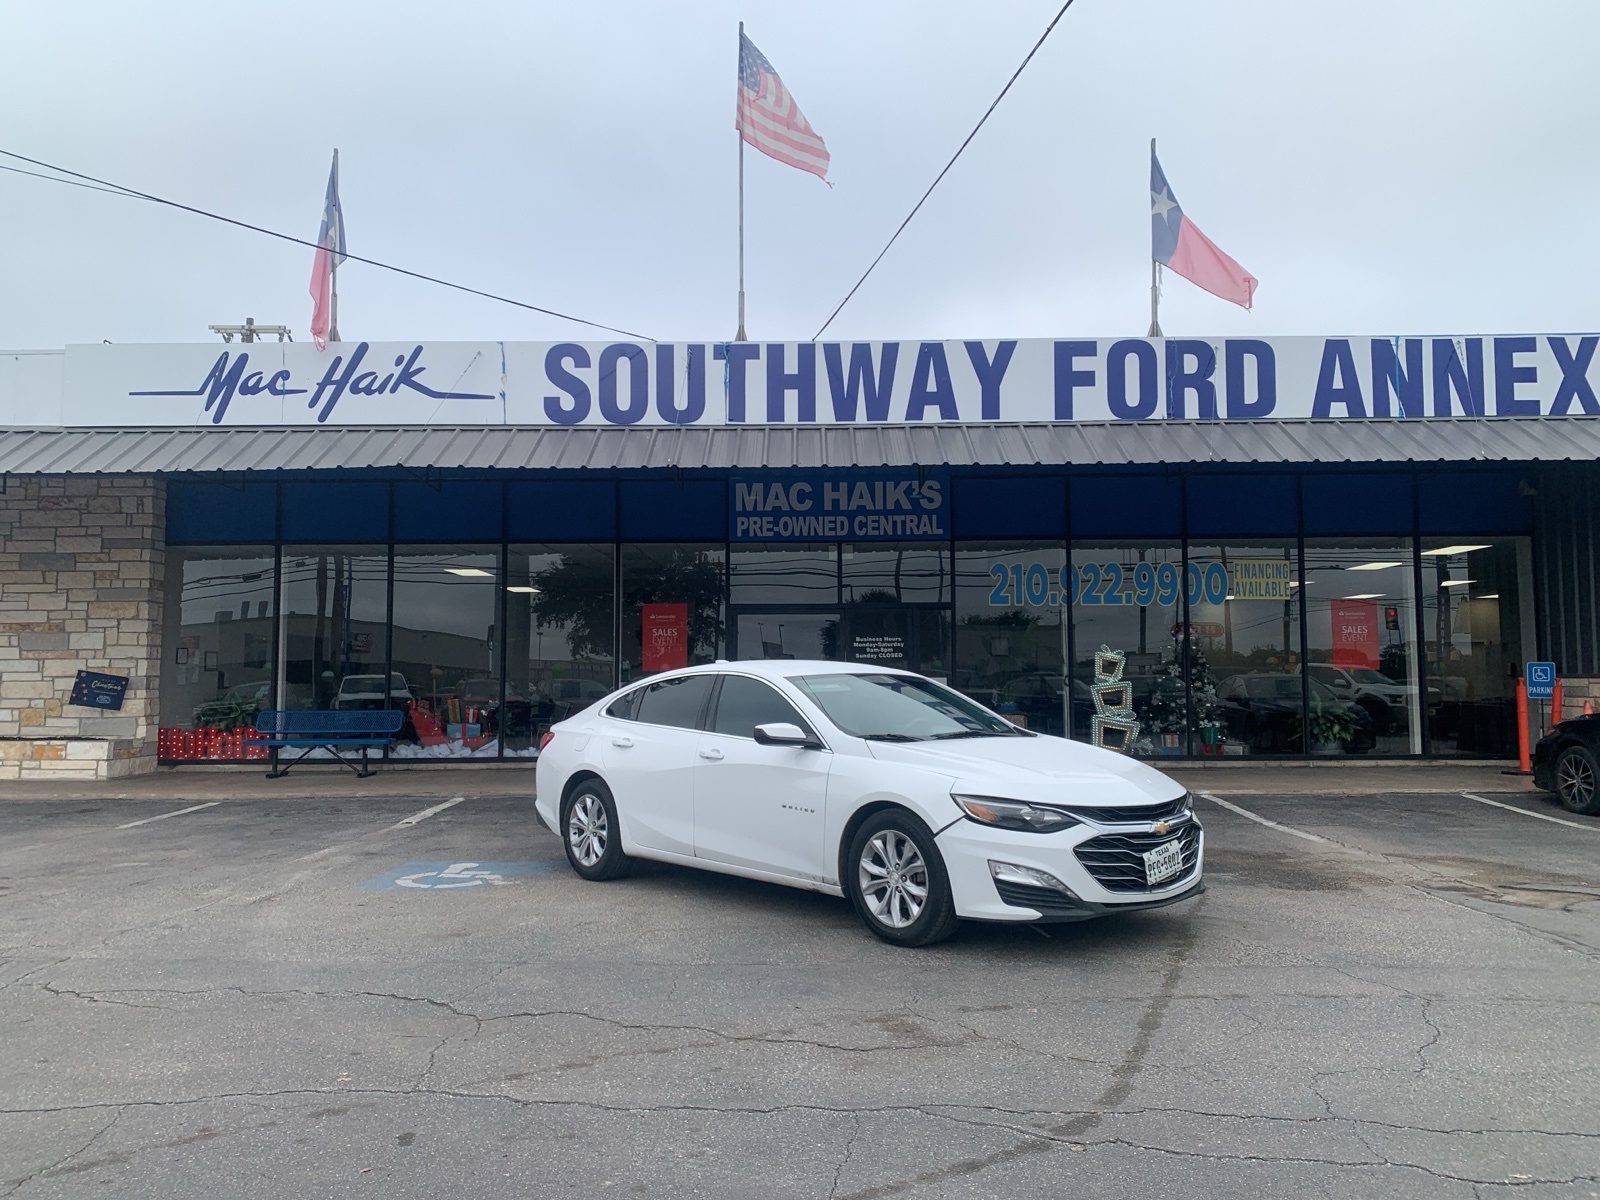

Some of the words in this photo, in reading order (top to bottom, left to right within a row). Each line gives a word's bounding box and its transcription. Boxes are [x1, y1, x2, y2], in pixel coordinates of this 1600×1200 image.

[129, 351, 308, 424] Mac
[309, 342, 496, 423] Haik
[543, 341, 1018, 424] SOUTHWAY
[1054, 339, 1277, 421] FORD
[1311, 337, 1600, 418] ANNEX
[735, 482, 813, 512] MAC
[823, 480, 943, 511] HAIK'S
[736, 516, 849, 537] PRE-OWNED
[854, 515, 944, 536] CENTRAL
[1234, 563, 1289, 580] FINANCING
[989, 561, 1228, 606] 210.922.9900
[1234, 581, 1290, 597] AVAILABLE
[652, 628, 678, 636] SALES
[1342, 625, 1368, 634] SALES
[652, 636, 677, 644] EVENT
[1342, 634, 1368, 642] EVENT
[1155, 846, 1170, 857] TEXAS
